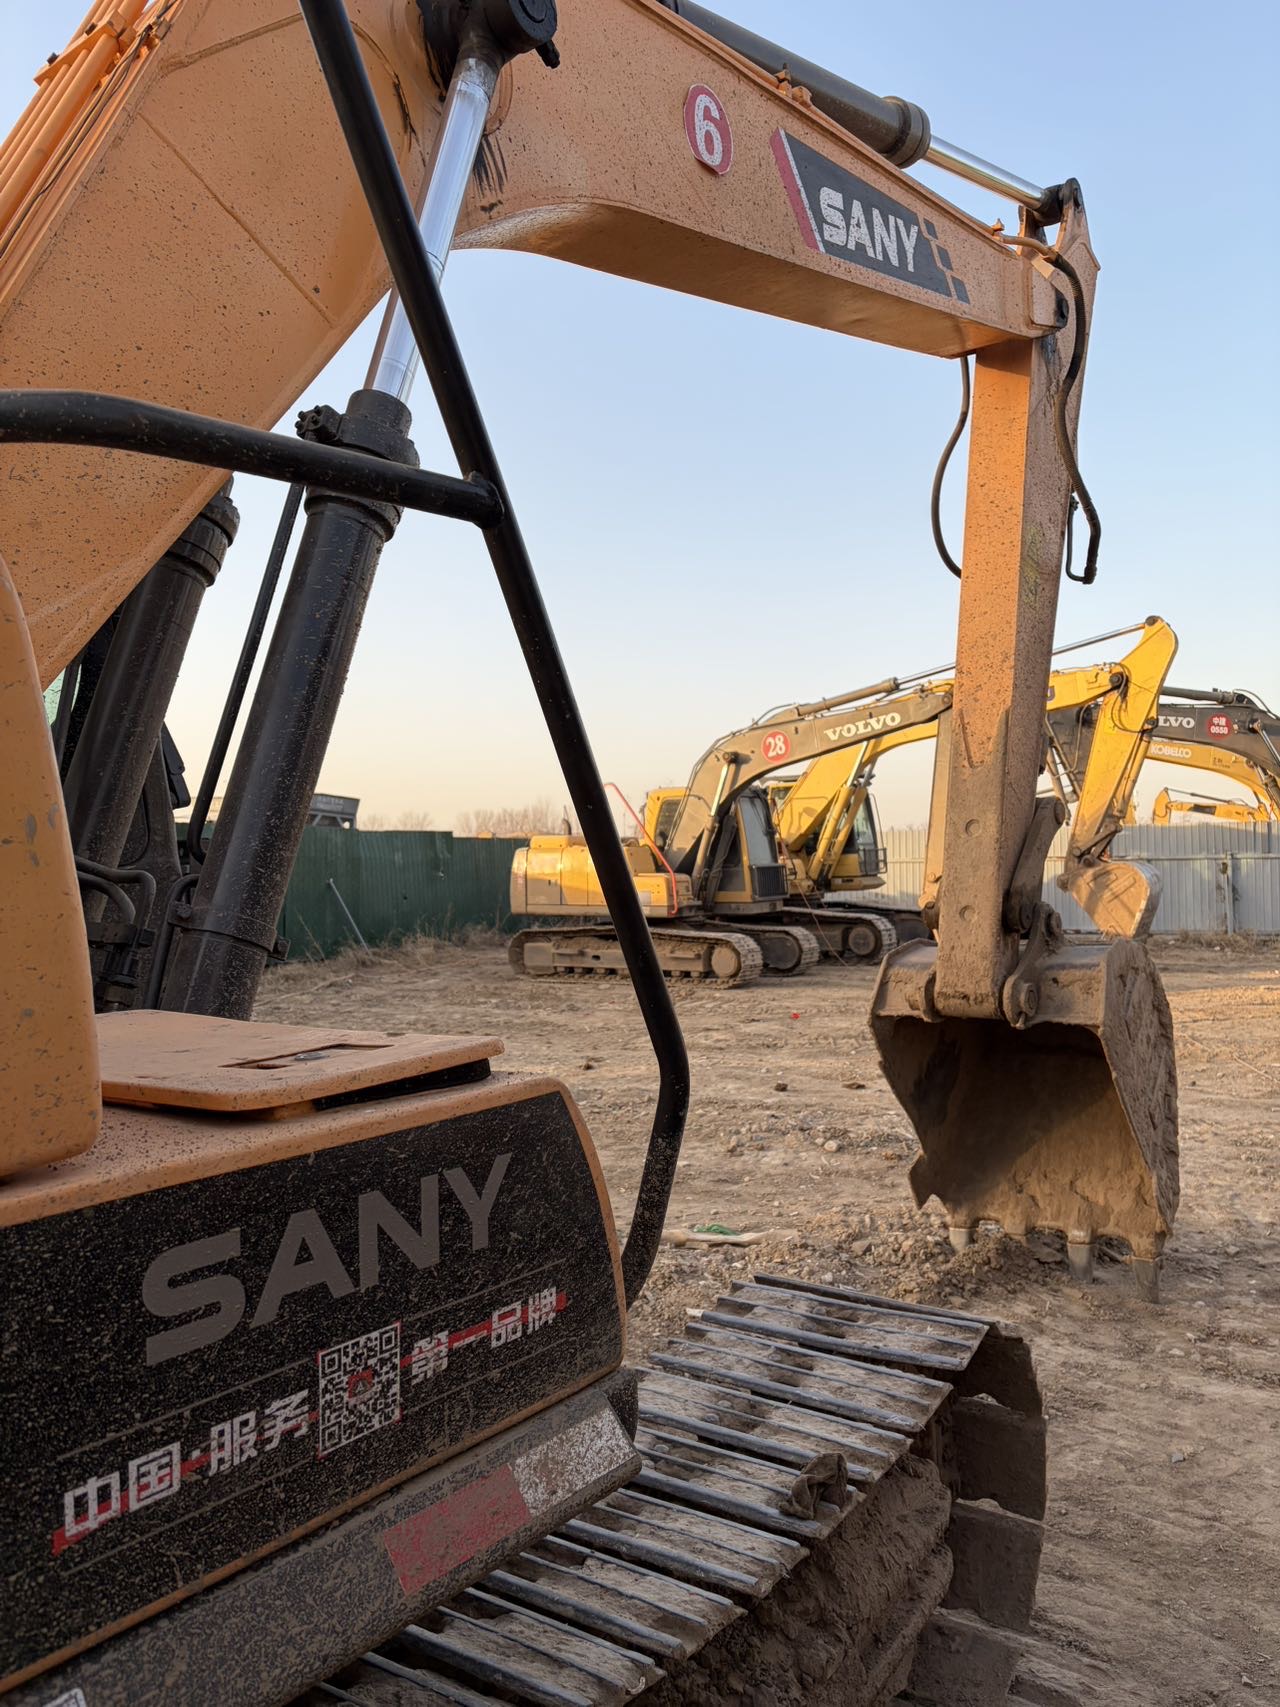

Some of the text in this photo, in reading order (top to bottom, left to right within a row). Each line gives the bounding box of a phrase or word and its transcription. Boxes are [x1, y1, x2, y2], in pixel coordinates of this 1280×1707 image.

[693, 93, 723, 168] 6
[818, 185, 920, 273] SANY
[765, 735, 786, 758] 28
[824, 712, 901, 741] VOLVO
[1158, 715, 1195, 729] LVO
[1151, 743, 1192, 759] KOBELCO
[141, 1152, 513, 1367] SANY
[409, 1285, 558, 1385] 第一品牌
